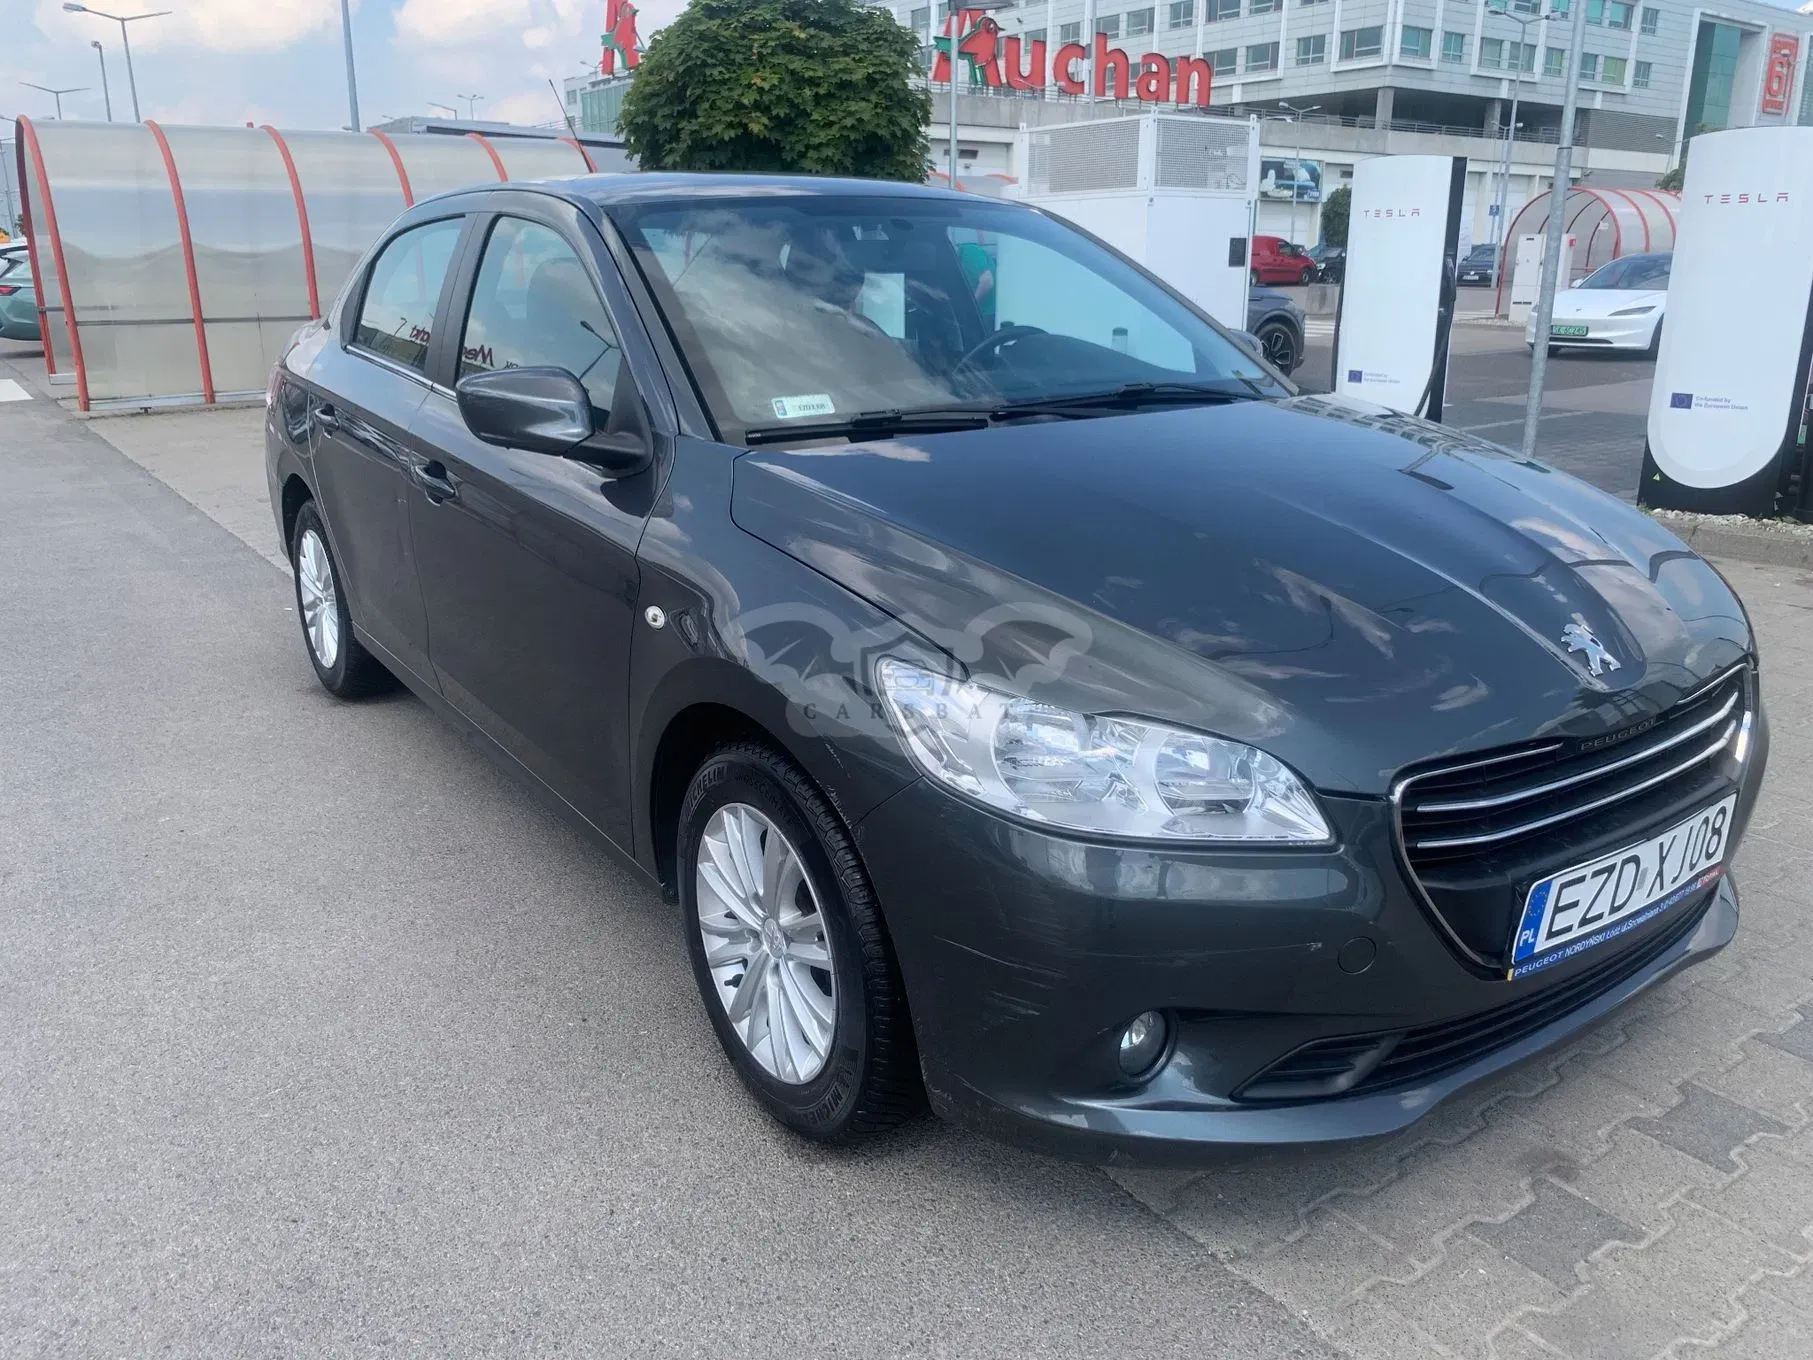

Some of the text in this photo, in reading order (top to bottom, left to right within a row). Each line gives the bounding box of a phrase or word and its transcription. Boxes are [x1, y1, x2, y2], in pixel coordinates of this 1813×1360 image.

[931, 9, 1212, 107] Auchan
[1363, 208, 1420, 218] TESLA
[1704, 192, 1789, 204] TESLA
[1581, 719, 1655, 751] PEUGEOT
[1545, 805, 1727, 940] EZD XJ08
[1518, 928, 1536, 947] PL
[1514, 951, 1564, 977] PEUGEOT
[1564, 931, 1606, 958] NORDYŃSKI
